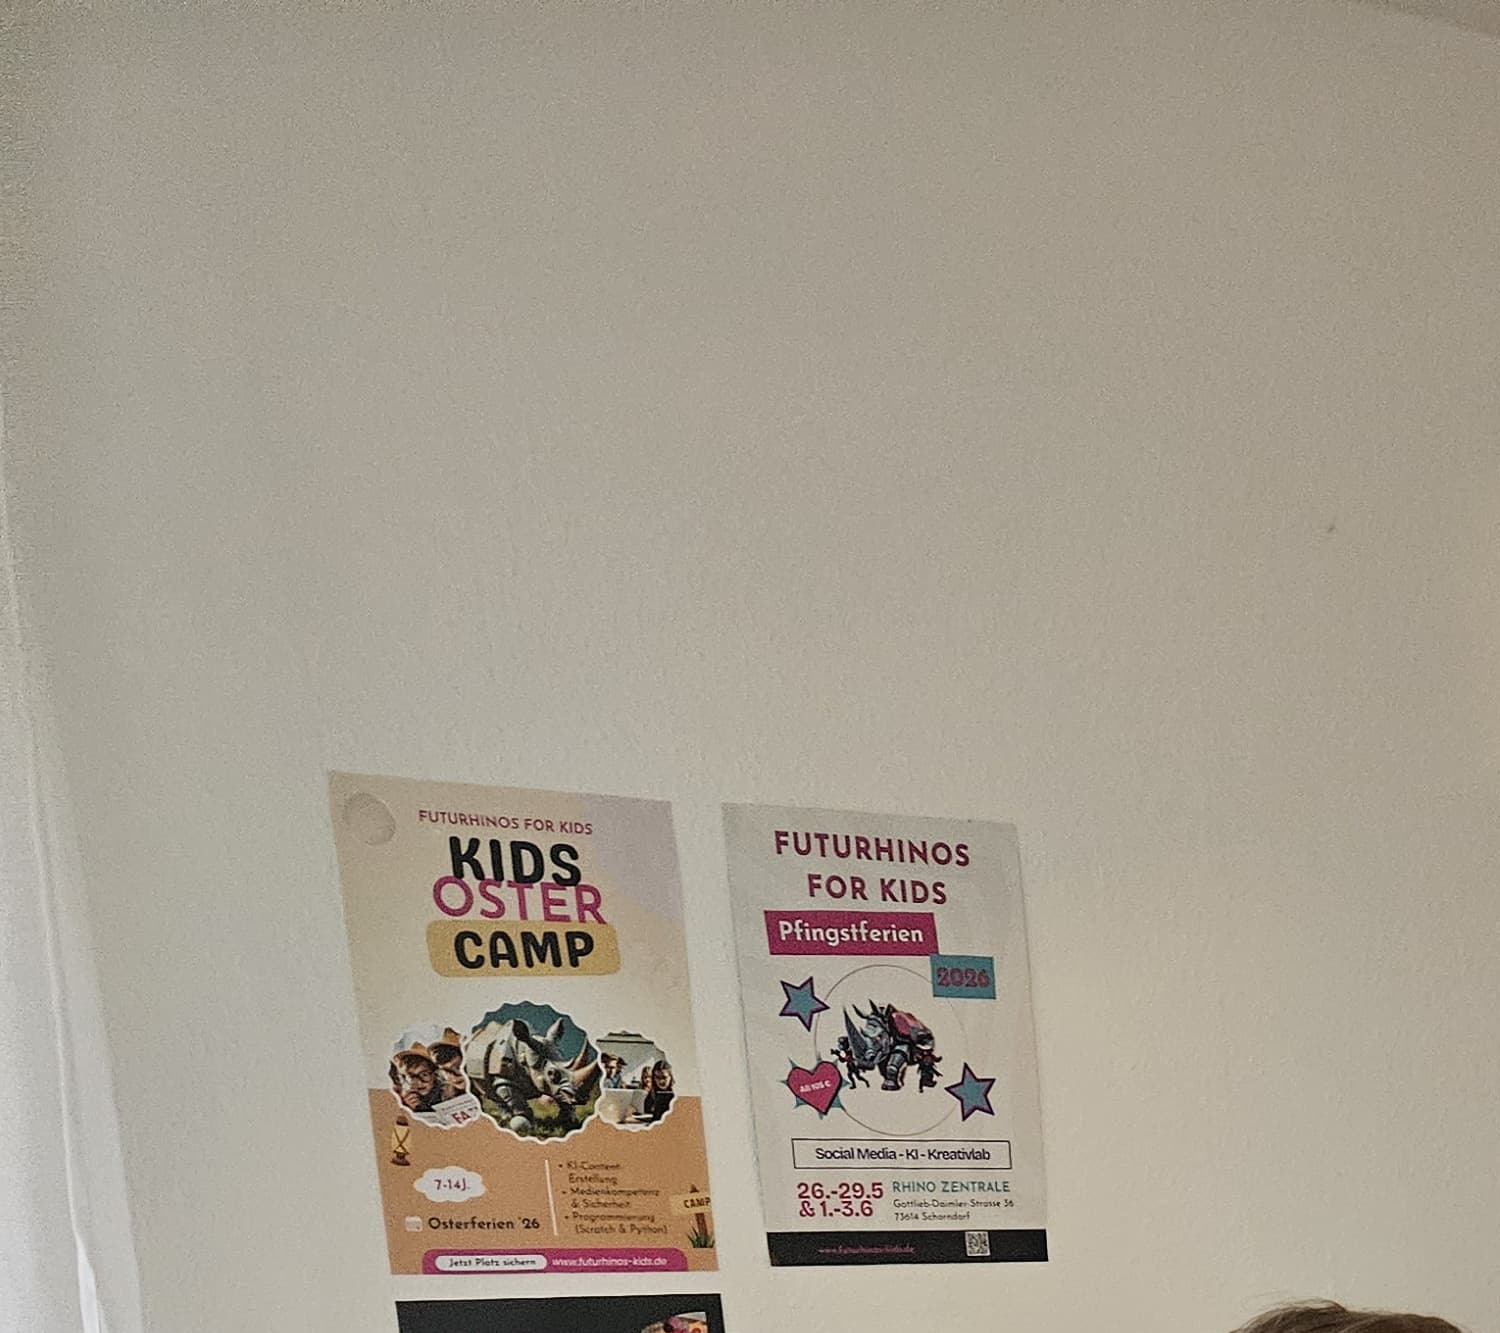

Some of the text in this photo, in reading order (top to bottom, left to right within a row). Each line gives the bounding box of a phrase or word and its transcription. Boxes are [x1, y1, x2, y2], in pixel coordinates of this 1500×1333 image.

[418, 810, 593, 835] FUTURHINOS FOR KIDS
[774, 830, 971, 868] FUTURHINOS
[449, 836, 582, 886] KIDS
[433, 875, 607, 925] OSTER
[807, 873, 948, 905] FOR KIDS
[778, 919, 924, 946] Pfingstferien
[454, 930, 595, 970] CAMP
[935, 967, 990, 988] 2026
[815, 1147, 855, 1161] Social
[857, 1147, 897, 1161] Media
[906, 1148, 919, 1160] KI
[927, 1148, 991, 1161] Kreativlab
[568, 1173, 618, 1185] Erstellung
[892, 1180, 1011, 1193] RHINO ZENTRALE
[797, 1182, 884, 1200] 26.-29.5
[799, 1200, 874, 1217] & 1.-3.6
[428, 1215, 515, 1231] Osterferien
